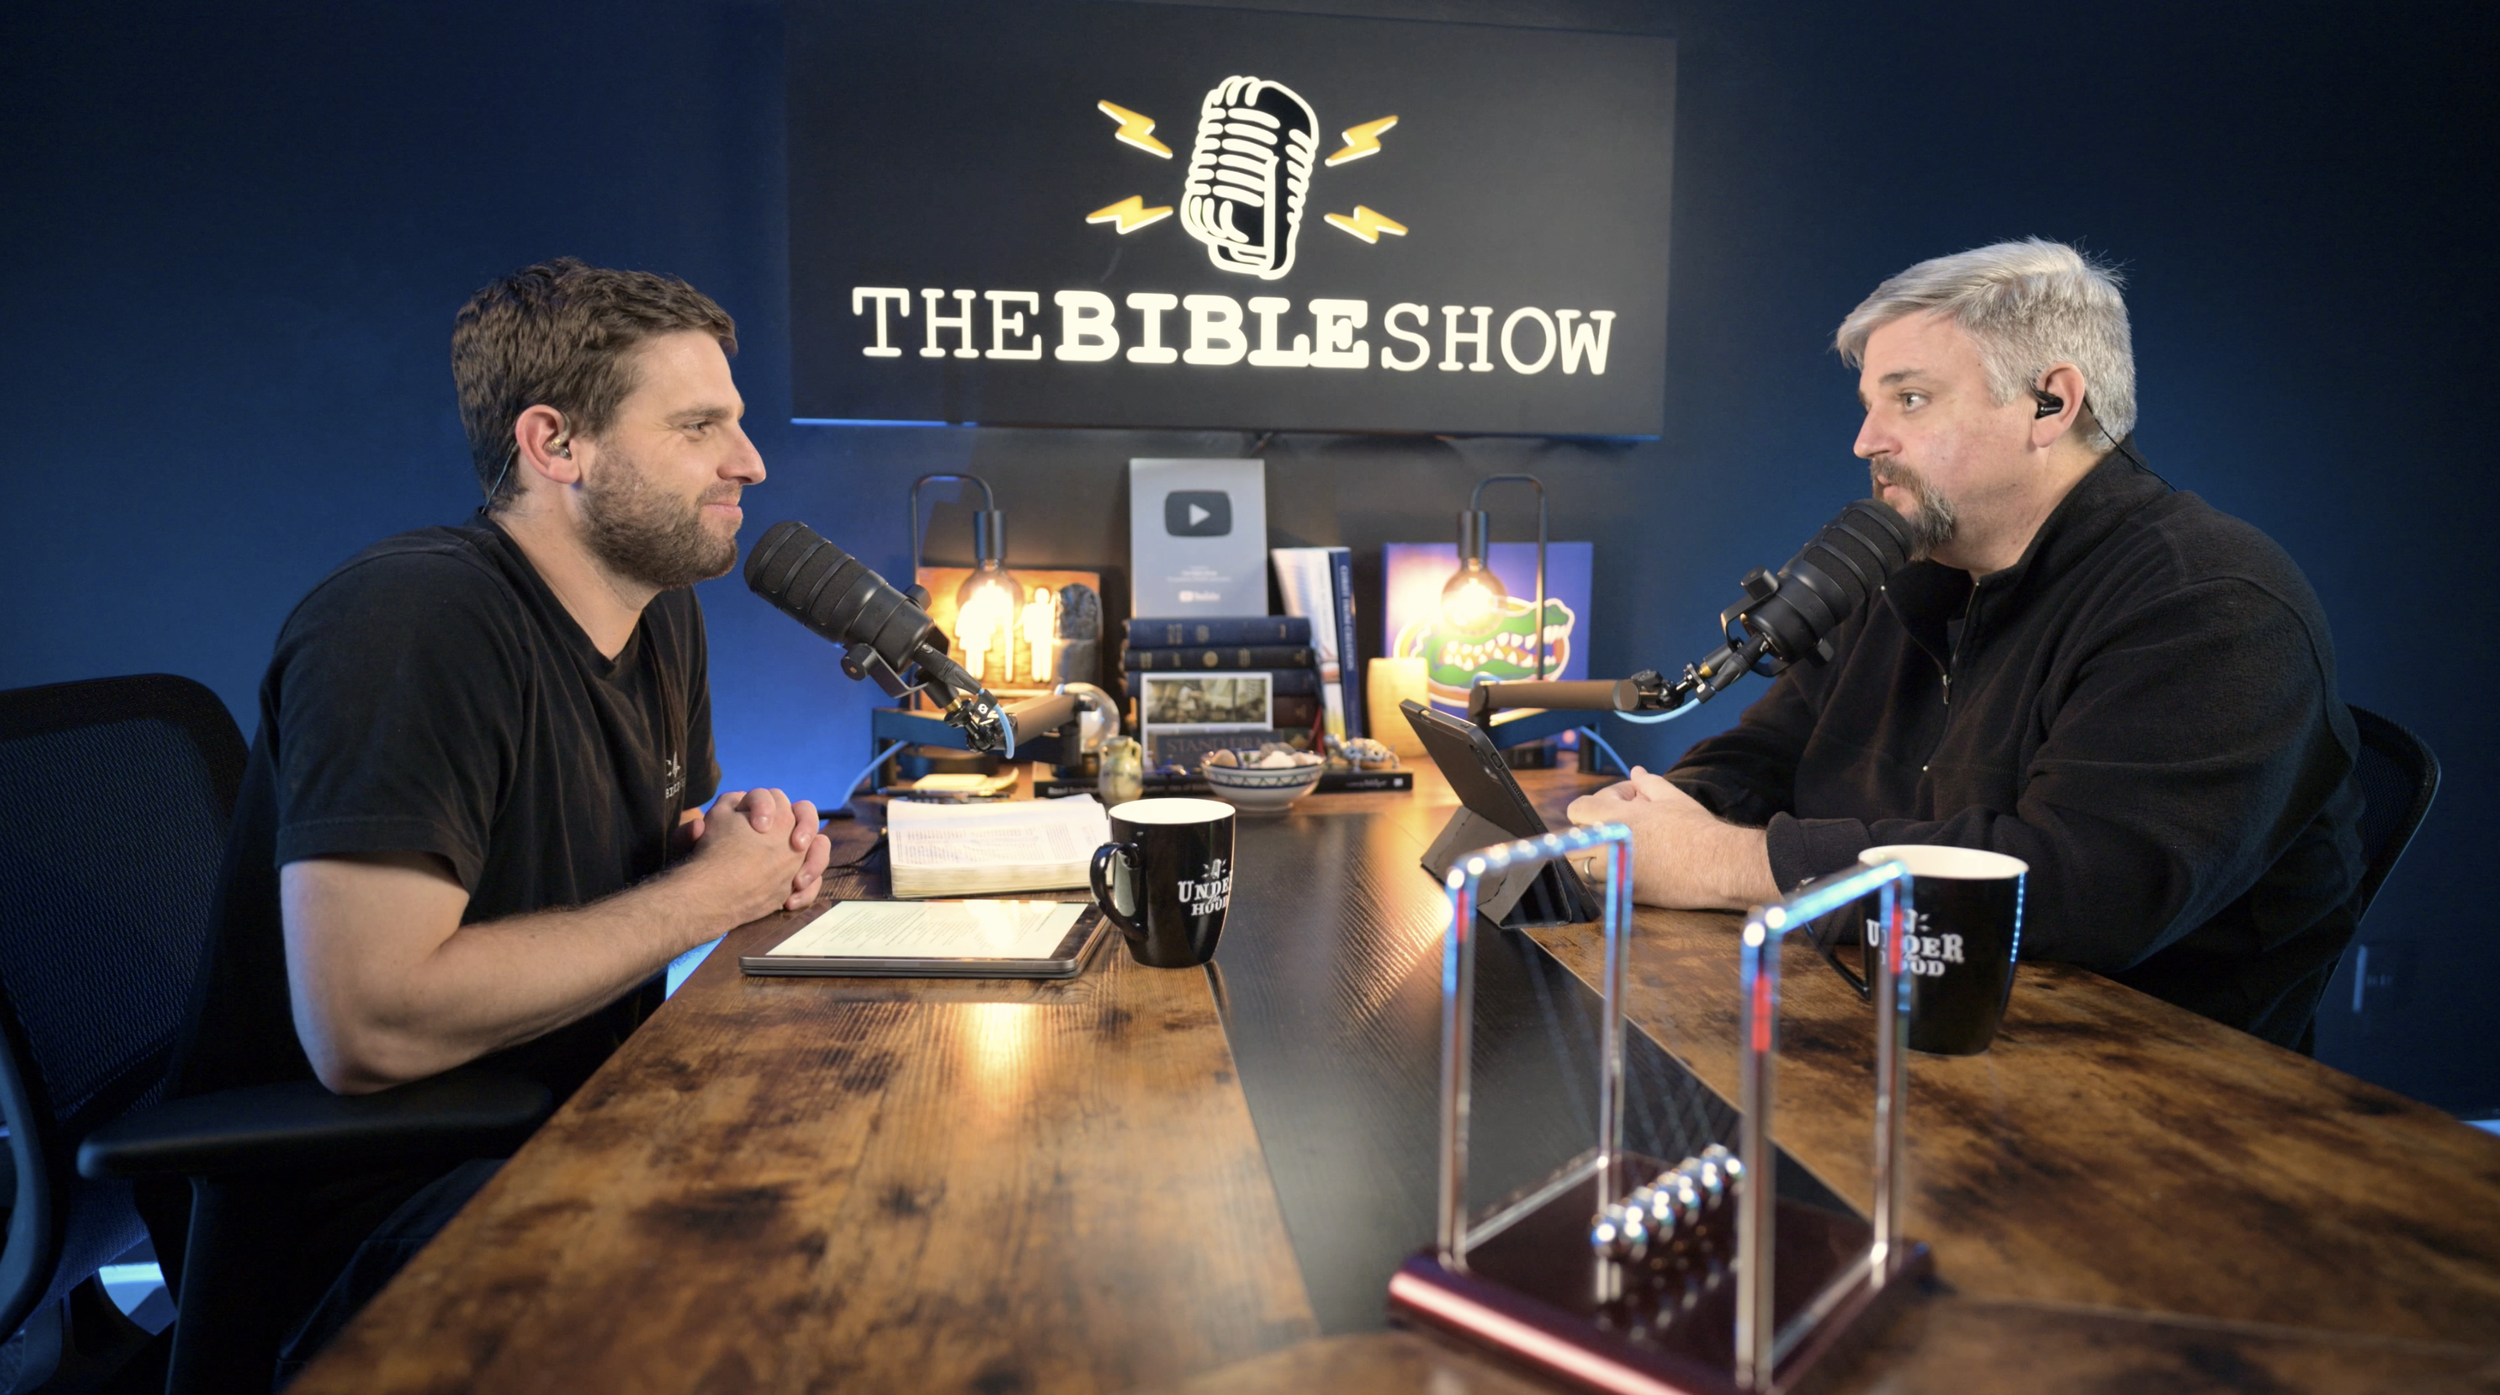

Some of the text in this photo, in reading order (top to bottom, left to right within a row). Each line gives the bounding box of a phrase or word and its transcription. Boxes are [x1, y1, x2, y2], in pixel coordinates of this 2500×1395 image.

[852, 286, 1617, 375] THE BIBLE SHOW
[1177, 874, 1230, 903] UNDE
[1866, 918, 1964, 964] UDER
